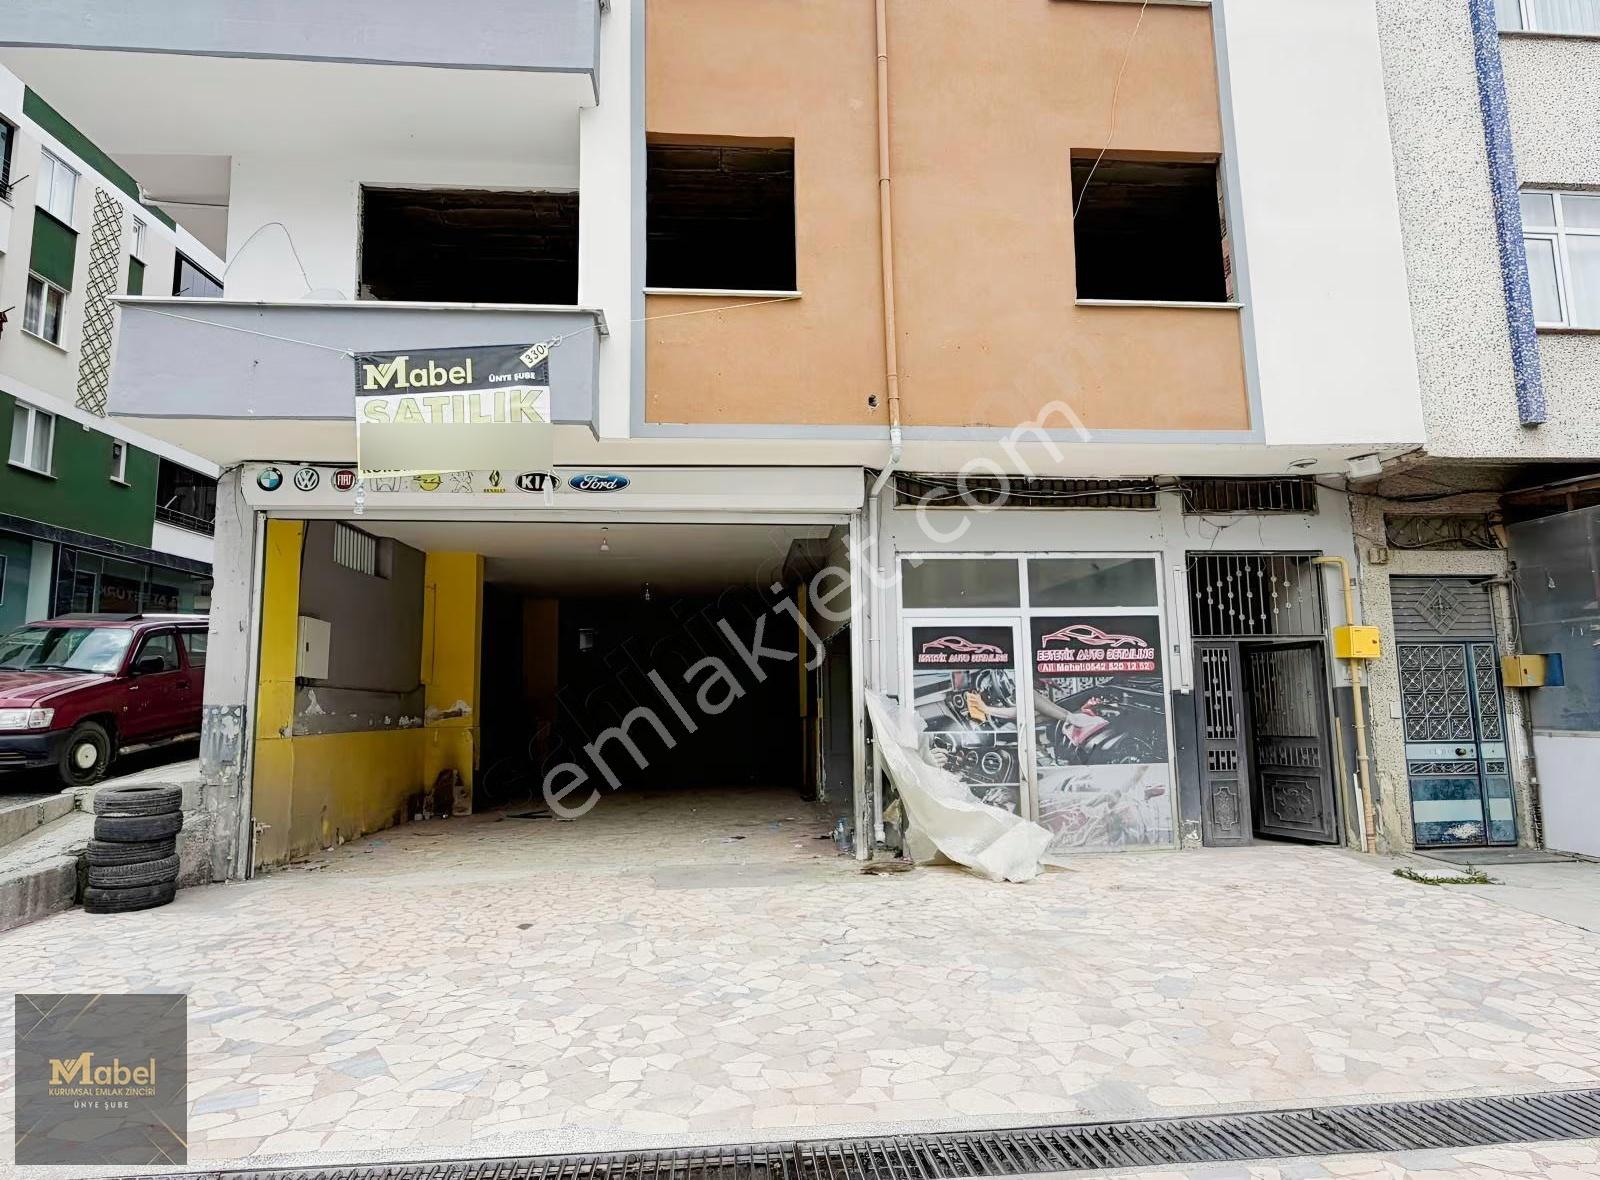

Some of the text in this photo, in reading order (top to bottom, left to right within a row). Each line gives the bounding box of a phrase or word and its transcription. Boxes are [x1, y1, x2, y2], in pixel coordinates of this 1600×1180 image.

[363, 356, 473, 390] Mabel
[364, 389, 545, 424] SATILIK
[580, 474, 617, 490] Ford
[1076, 648, 1104, 660] AUTO
